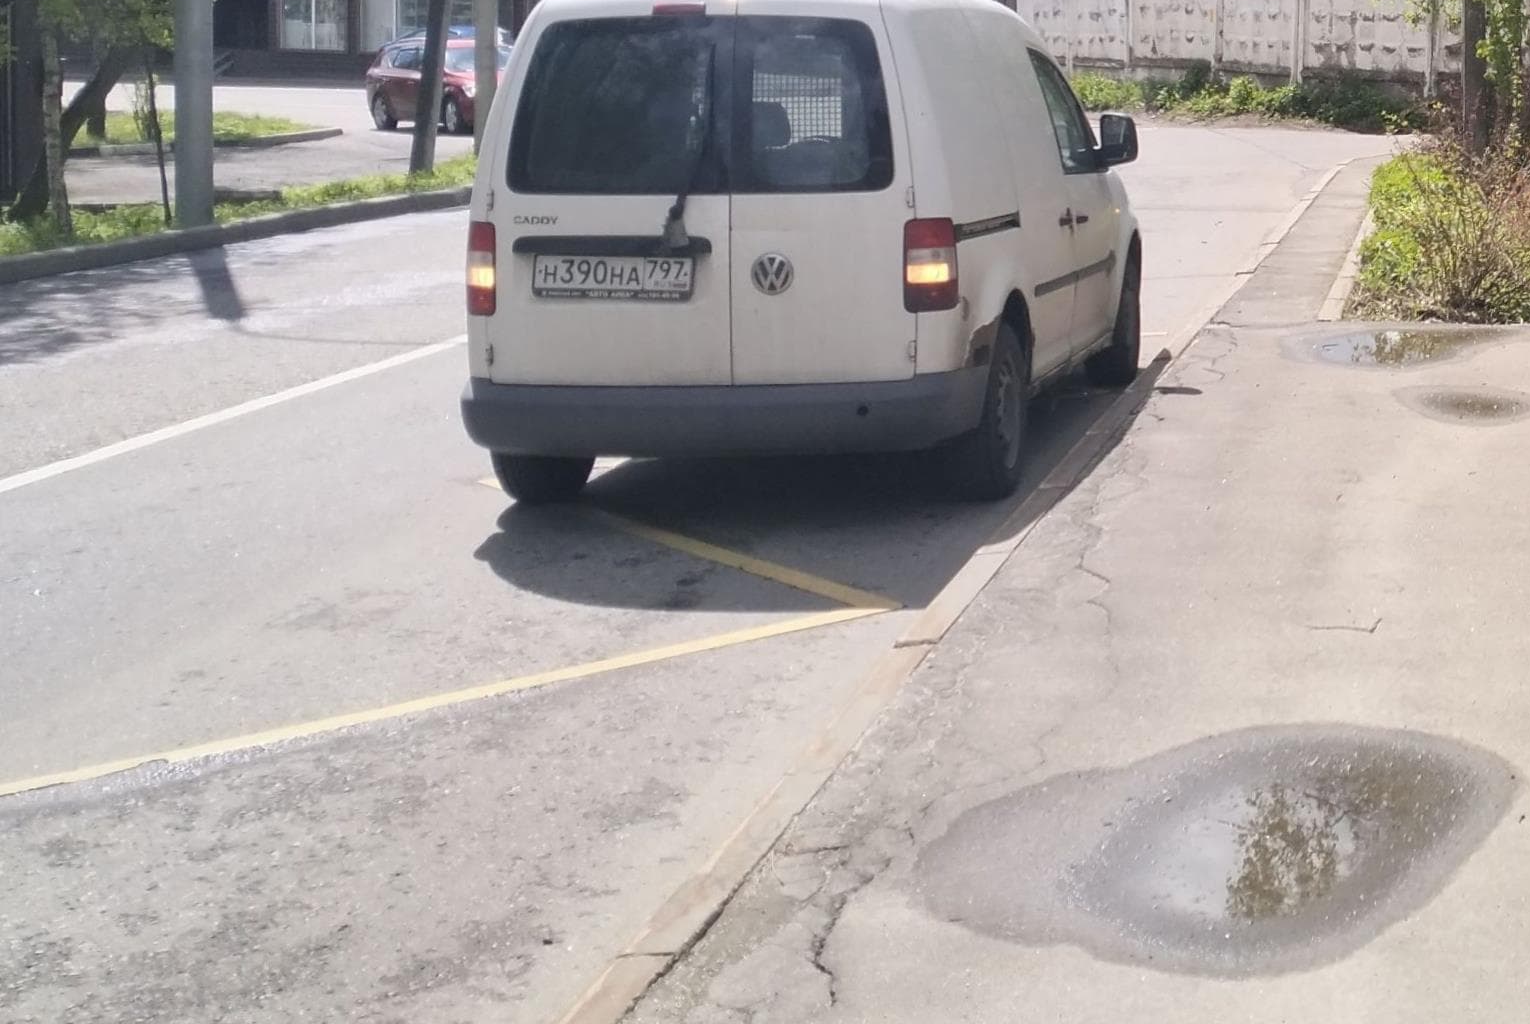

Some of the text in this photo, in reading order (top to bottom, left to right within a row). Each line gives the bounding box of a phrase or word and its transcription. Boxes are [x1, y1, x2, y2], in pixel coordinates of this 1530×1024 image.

[513, 215, 559, 225] CADDY
[543, 259, 686, 286] Н390НА 797
